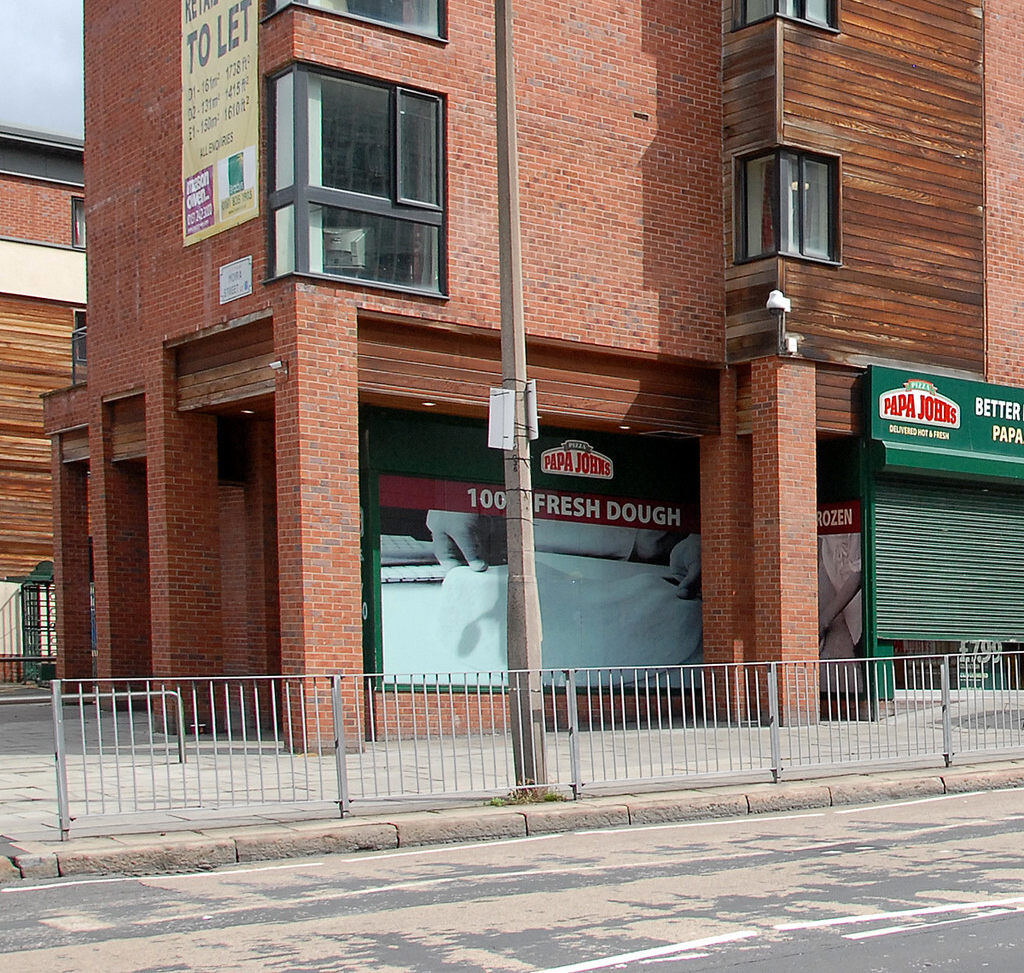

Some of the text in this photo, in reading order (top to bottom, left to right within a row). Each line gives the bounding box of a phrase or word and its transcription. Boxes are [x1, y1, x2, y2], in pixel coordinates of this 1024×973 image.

[187, 23, 211, 76] TO
[884, 394, 957, 424] PAPA JOHNS
[975, 397, 1021, 421] BETTER
[889, 424, 950, 440] DELIVERED HOT & FRESH
[544, 449, 574, 472] PAPA
[575, 451, 611, 477] JOHNS
[535, 493, 601, 519] FRESH
[606, 500, 681, 527] DOUGH
[816, 508, 853, 527] ROZEN
